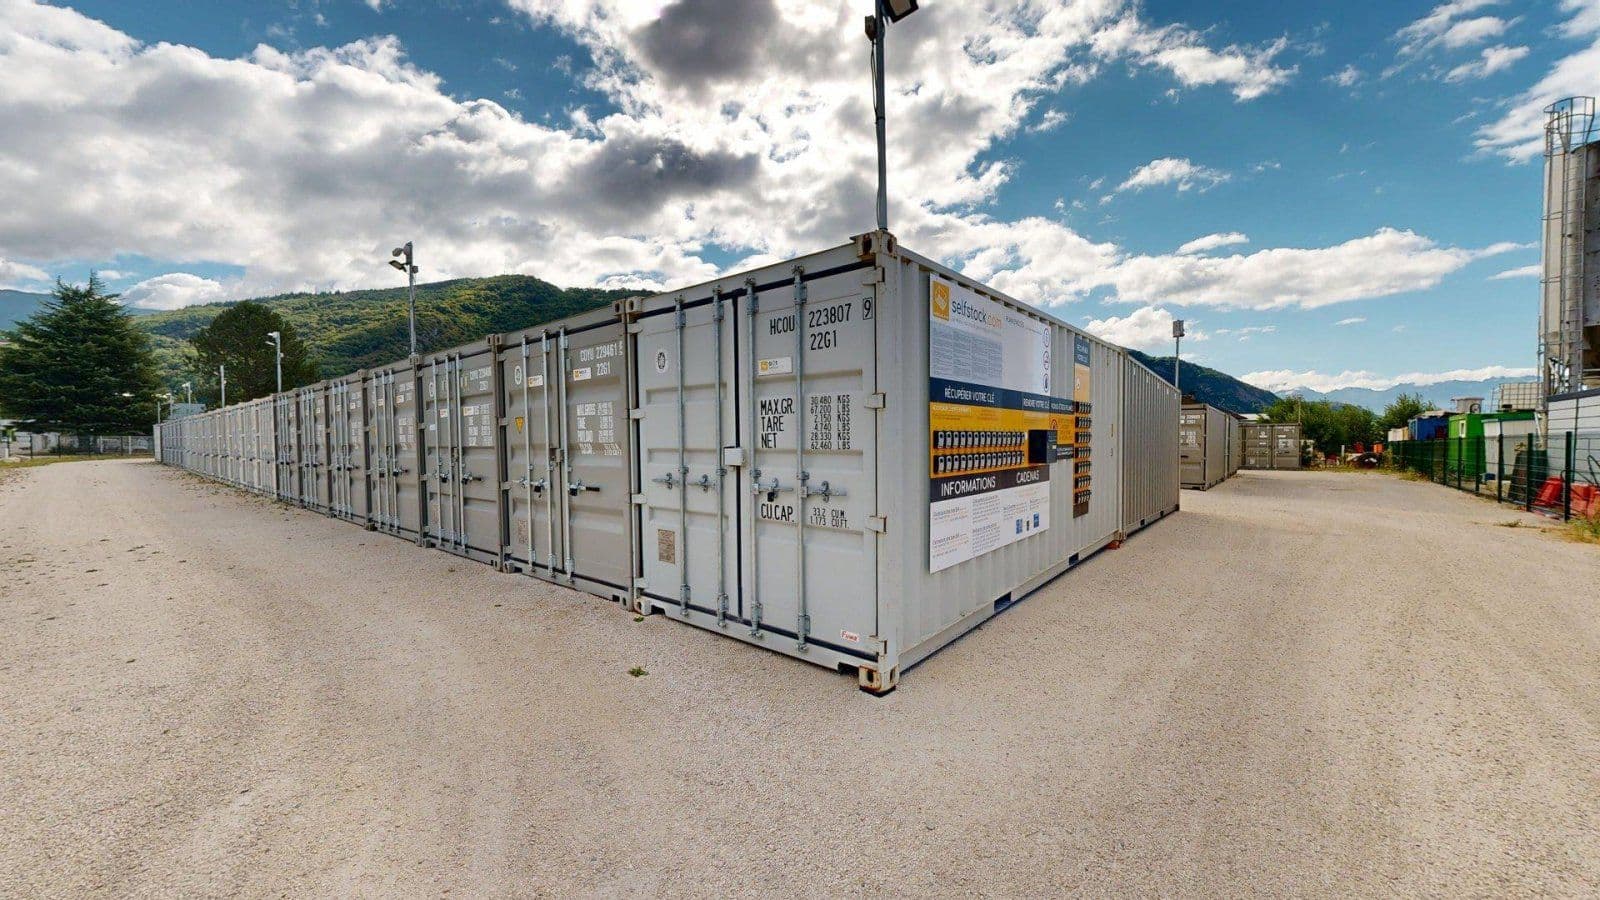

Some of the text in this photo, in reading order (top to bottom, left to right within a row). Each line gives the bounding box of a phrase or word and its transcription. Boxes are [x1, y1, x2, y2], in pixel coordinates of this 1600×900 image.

[770, 299, 872, 335] HCOU 223807 9
[951, 300, 1003, 328] selfstock.com
[810, 330, 837, 351] 22G1
[944, 385, 972, 400] RÉCUPÉRER
[972, 390, 986, 402] VOTRE
[760, 398, 795, 415] MAX.GR.
[761, 416, 785, 432] TARE
[761, 433, 777, 448] NET
[1016, 470, 1040, 483] CADENAS
[941, 476, 996, 496] INFORMATIONS
[761, 503, 794, 523] CU.CAP.
